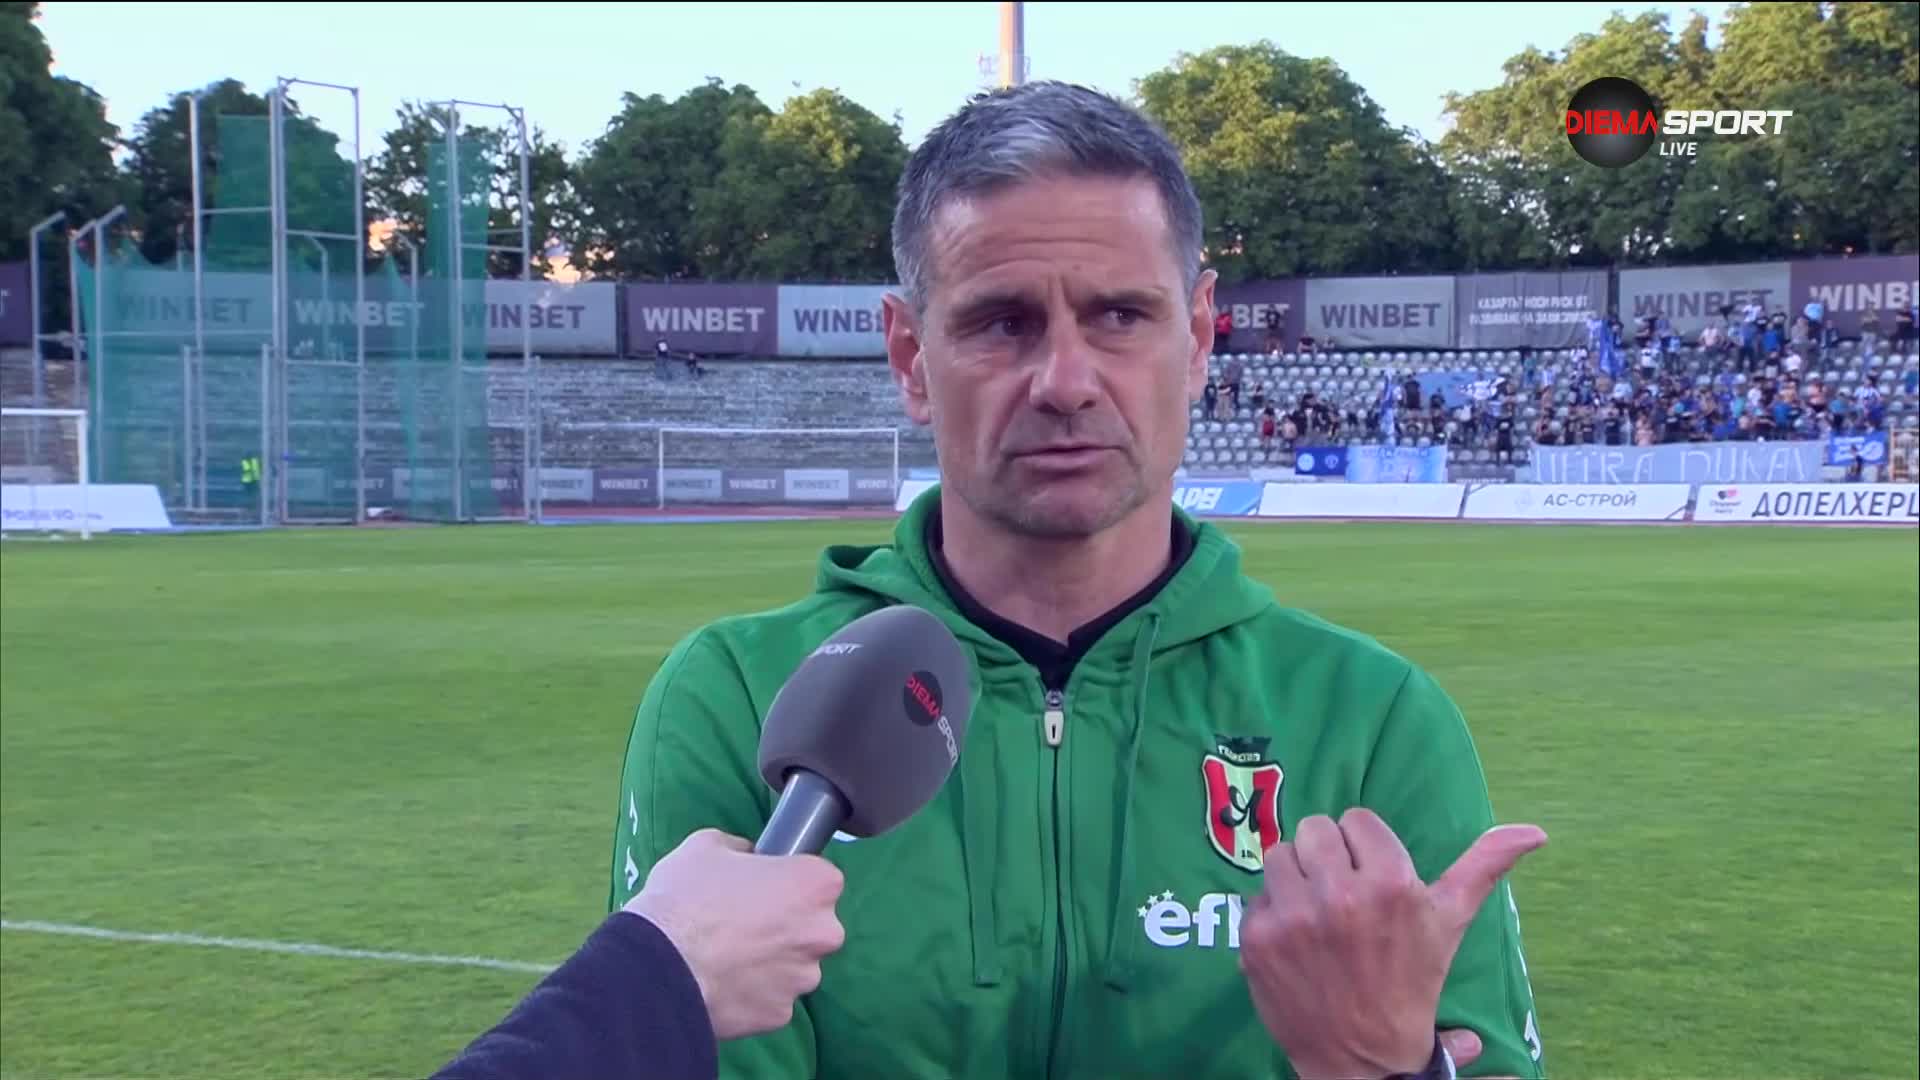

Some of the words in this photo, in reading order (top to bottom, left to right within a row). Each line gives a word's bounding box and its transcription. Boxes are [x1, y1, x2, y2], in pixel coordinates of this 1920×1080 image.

[295, 300, 424, 327] WINBET
[642, 307, 764, 333] WINBET
[1321, 303, 1441, 329] WINBET
[1544, 490, 1637, 507] АС-СТРОЙ
